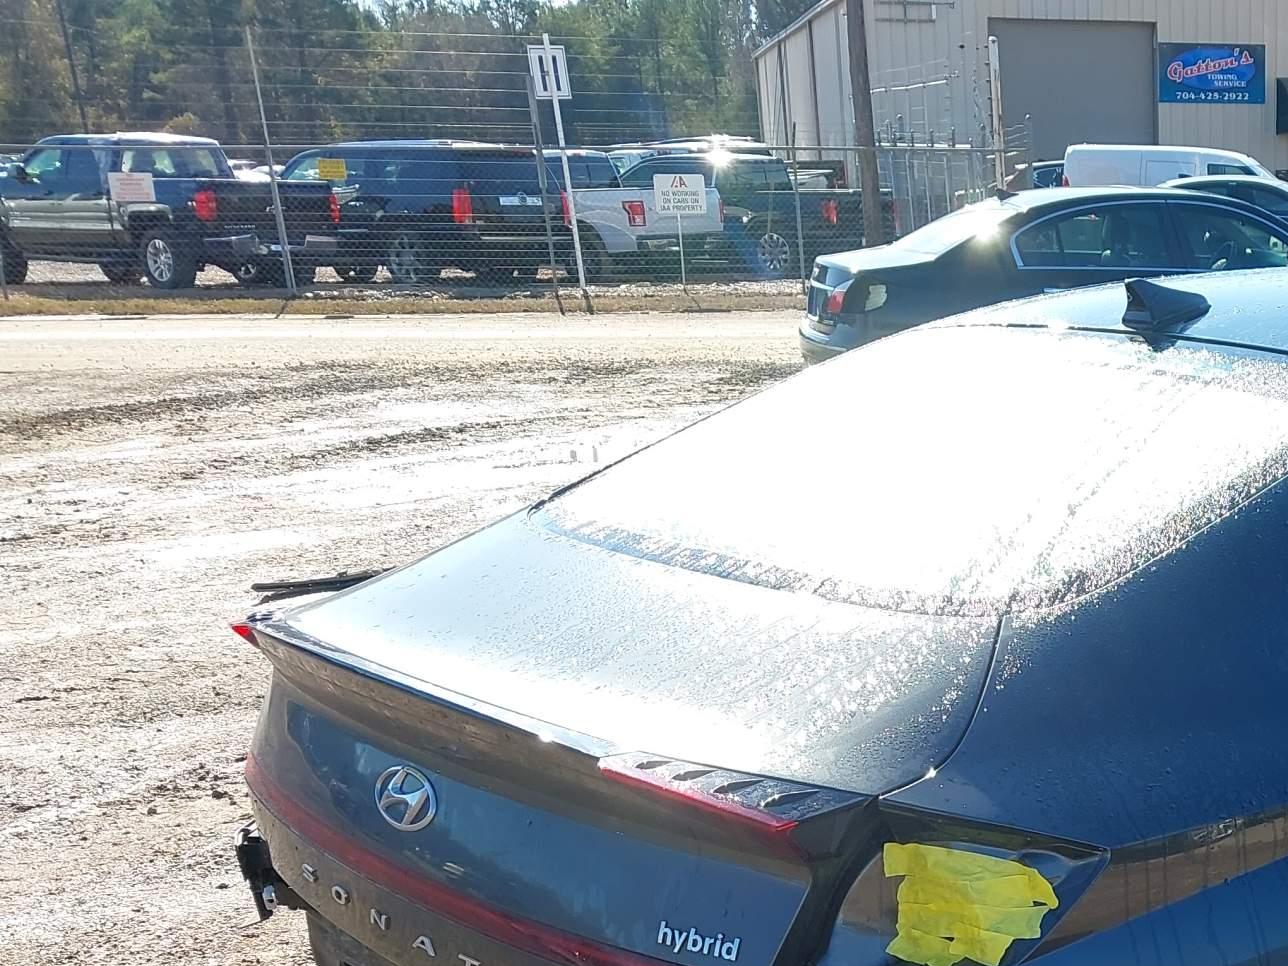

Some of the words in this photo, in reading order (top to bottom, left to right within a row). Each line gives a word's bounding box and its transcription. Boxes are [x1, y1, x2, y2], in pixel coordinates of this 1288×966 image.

[1167, 47, 1254, 82] Gatton's
[1214, 80, 1247, 88] SERVICE
[672, 197, 689, 205] CARS
[657, 920, 741, 962] hybrid
